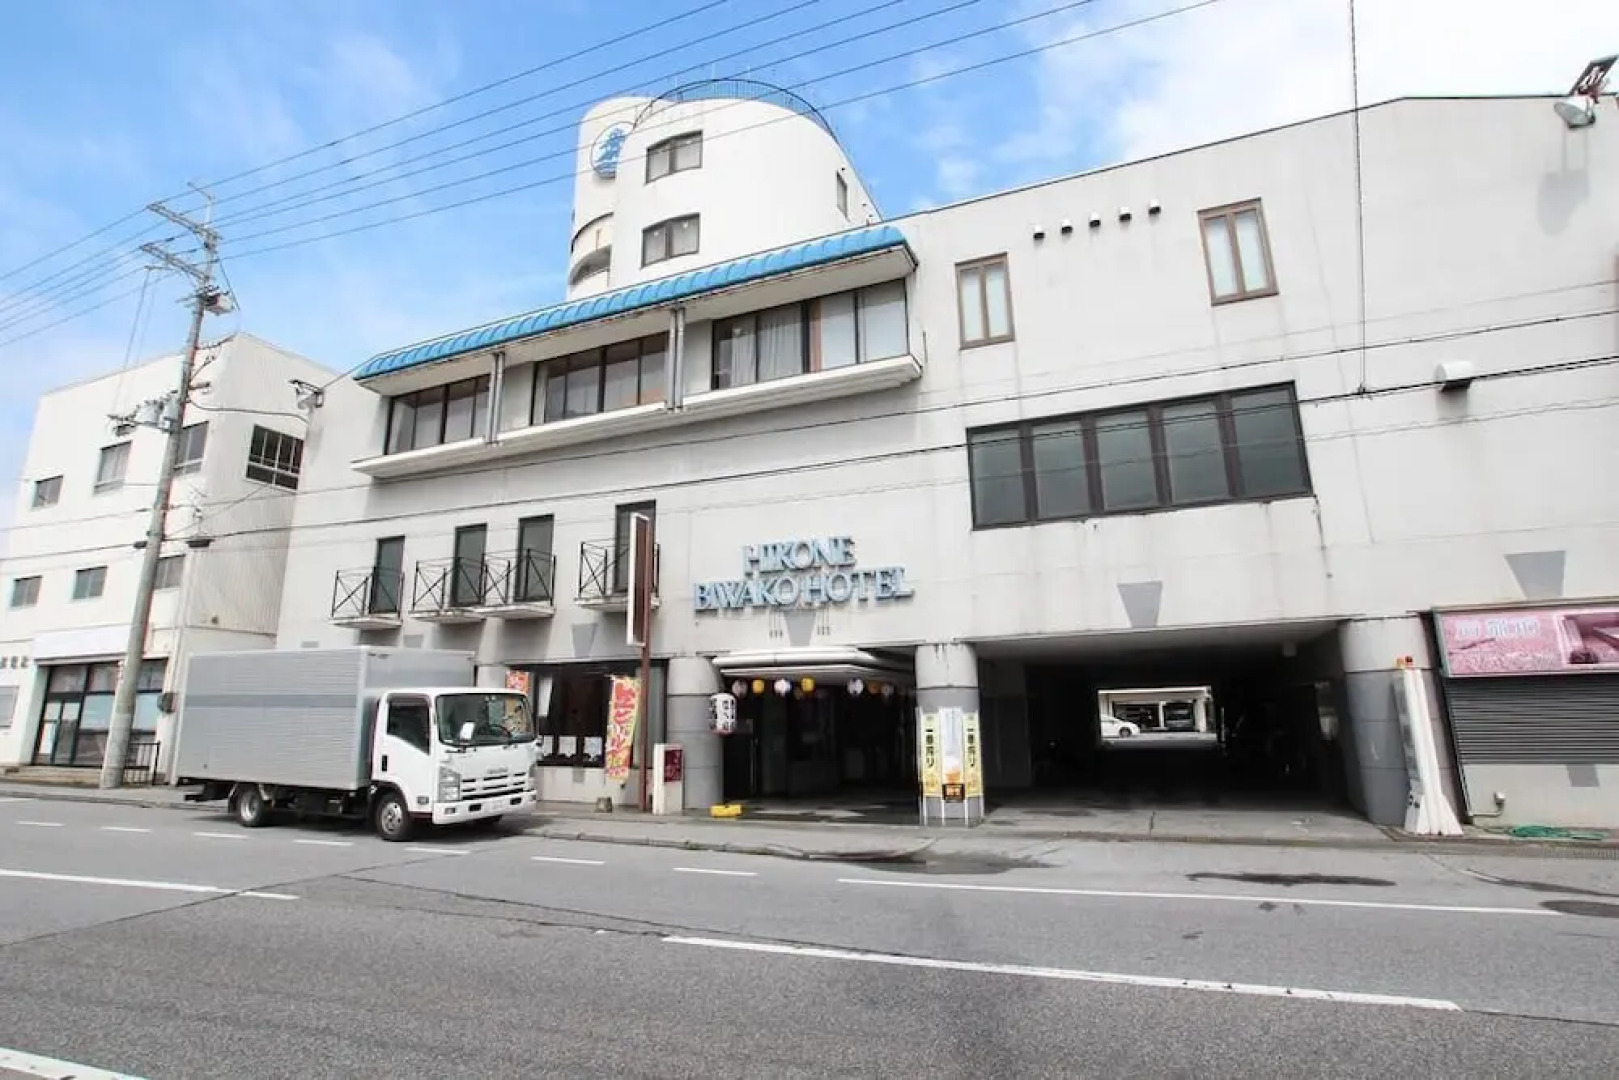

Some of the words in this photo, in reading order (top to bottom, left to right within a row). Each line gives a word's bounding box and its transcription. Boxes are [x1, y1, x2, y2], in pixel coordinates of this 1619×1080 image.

[743, 536, 857, 575] HIKONE
[694, 575, 799, 611] BIWAKO
[801, 564, 914, 605] HOTEL
